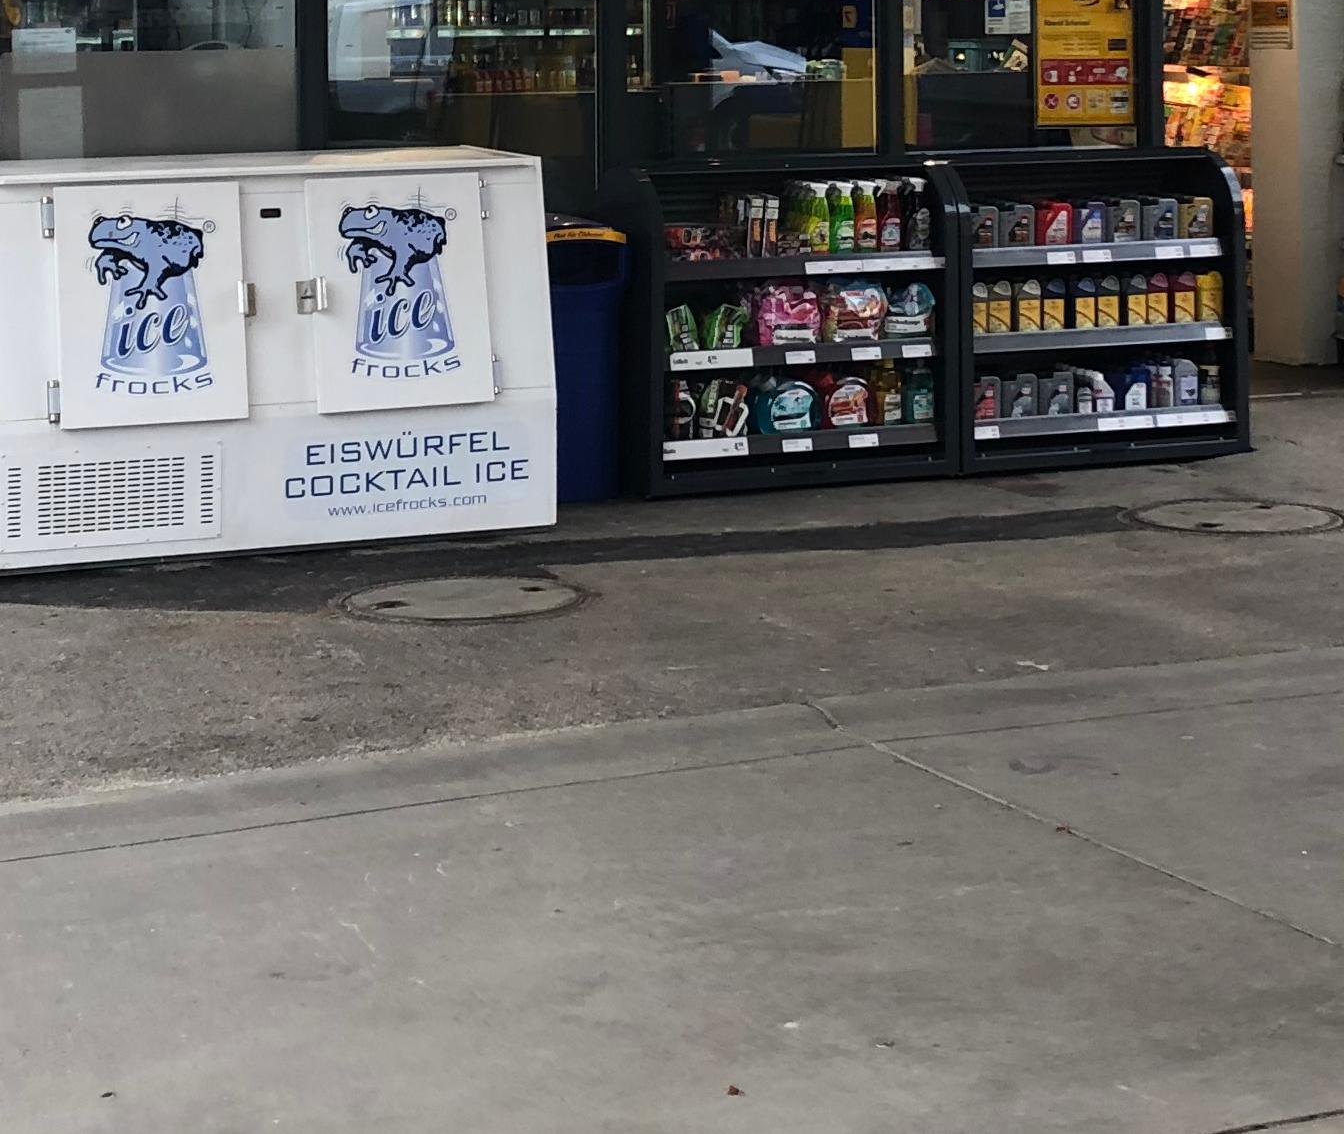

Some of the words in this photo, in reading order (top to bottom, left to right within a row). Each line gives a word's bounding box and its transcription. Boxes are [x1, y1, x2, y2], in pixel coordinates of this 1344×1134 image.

[116, 304, 189, 358] ice
[370, 290, 435, 344] ice
[95, 371, 214, 395] frocks
[351, 354, 462, 379] frocks
[305, 430, 510, 466] EISWÜRFEL
[284, 465, 462, 500] COCKTAIL
[475, 459, 530, 484] ICE
[327, 494, 488, 517] www.icefrocks.com
